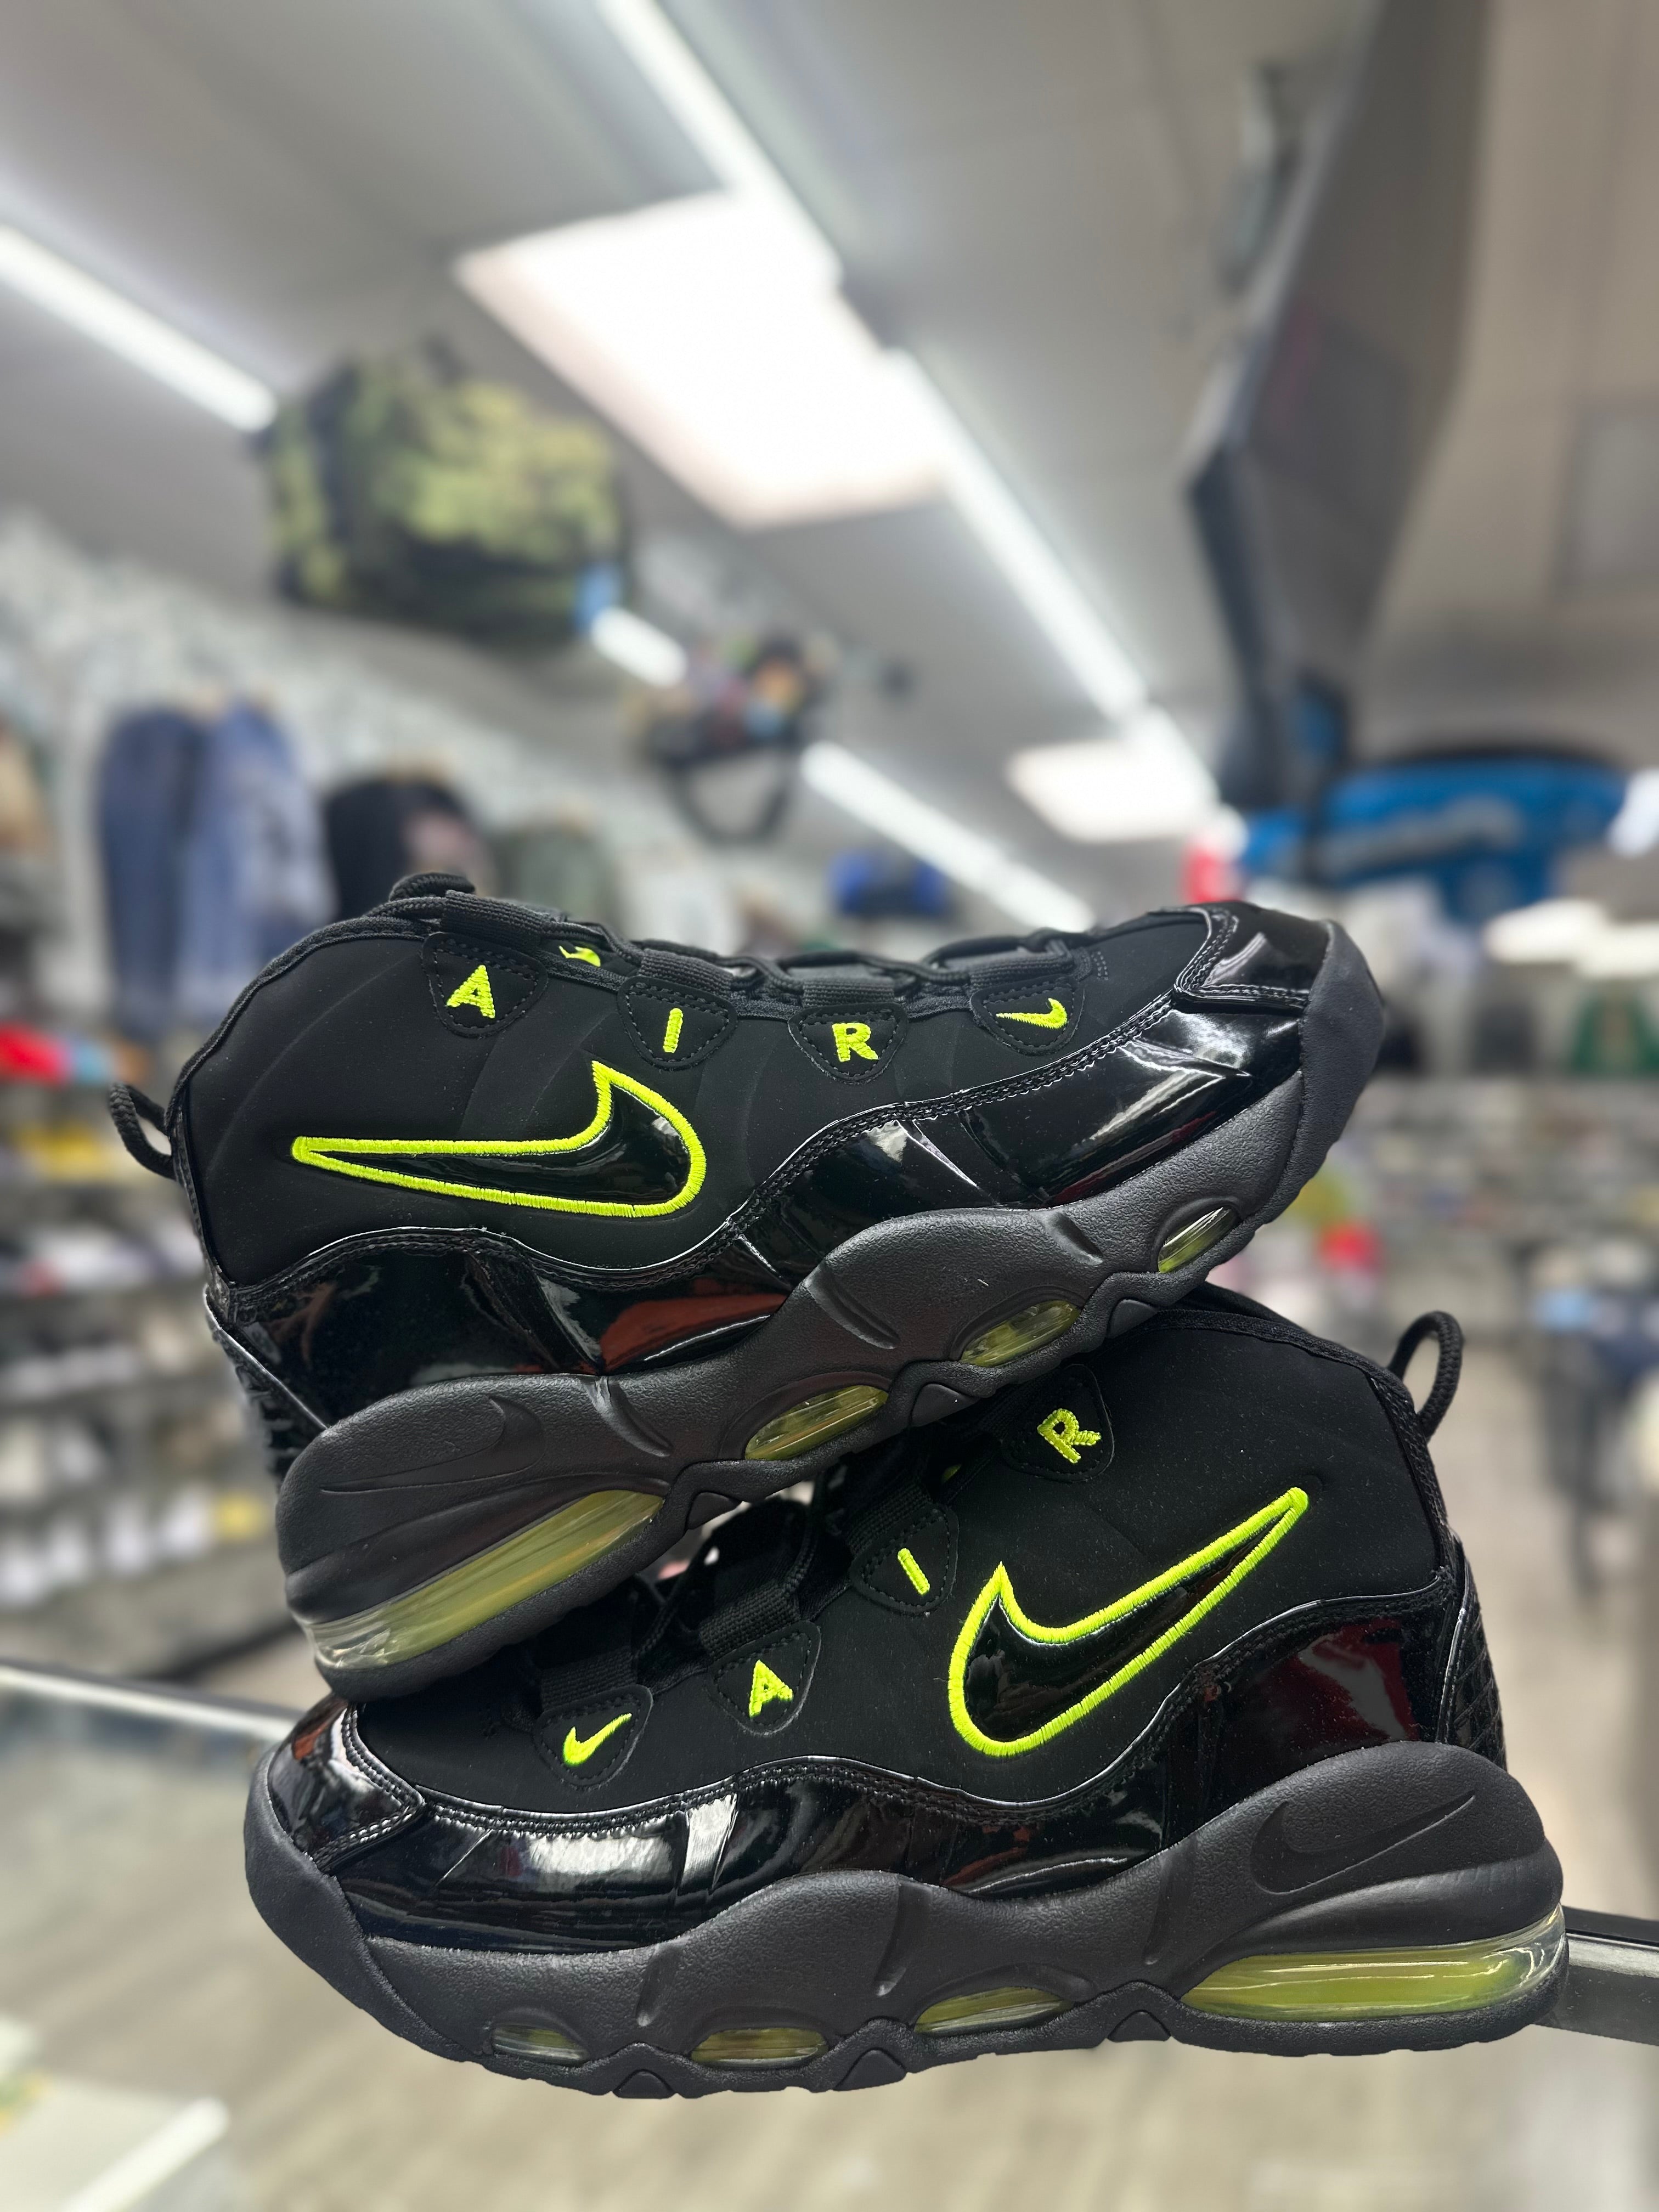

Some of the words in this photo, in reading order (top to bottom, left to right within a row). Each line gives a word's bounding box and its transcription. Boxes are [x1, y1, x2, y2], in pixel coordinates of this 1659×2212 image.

[446, 965, 496, 1019] A
[662, 1007, 684, 1053] I
[832, 1022, 878, 1063] R
[748, 1660, 794, 1718] A
[897, 1548, 930, 1596] I
[1037, 1408, 1102, 1465] R
